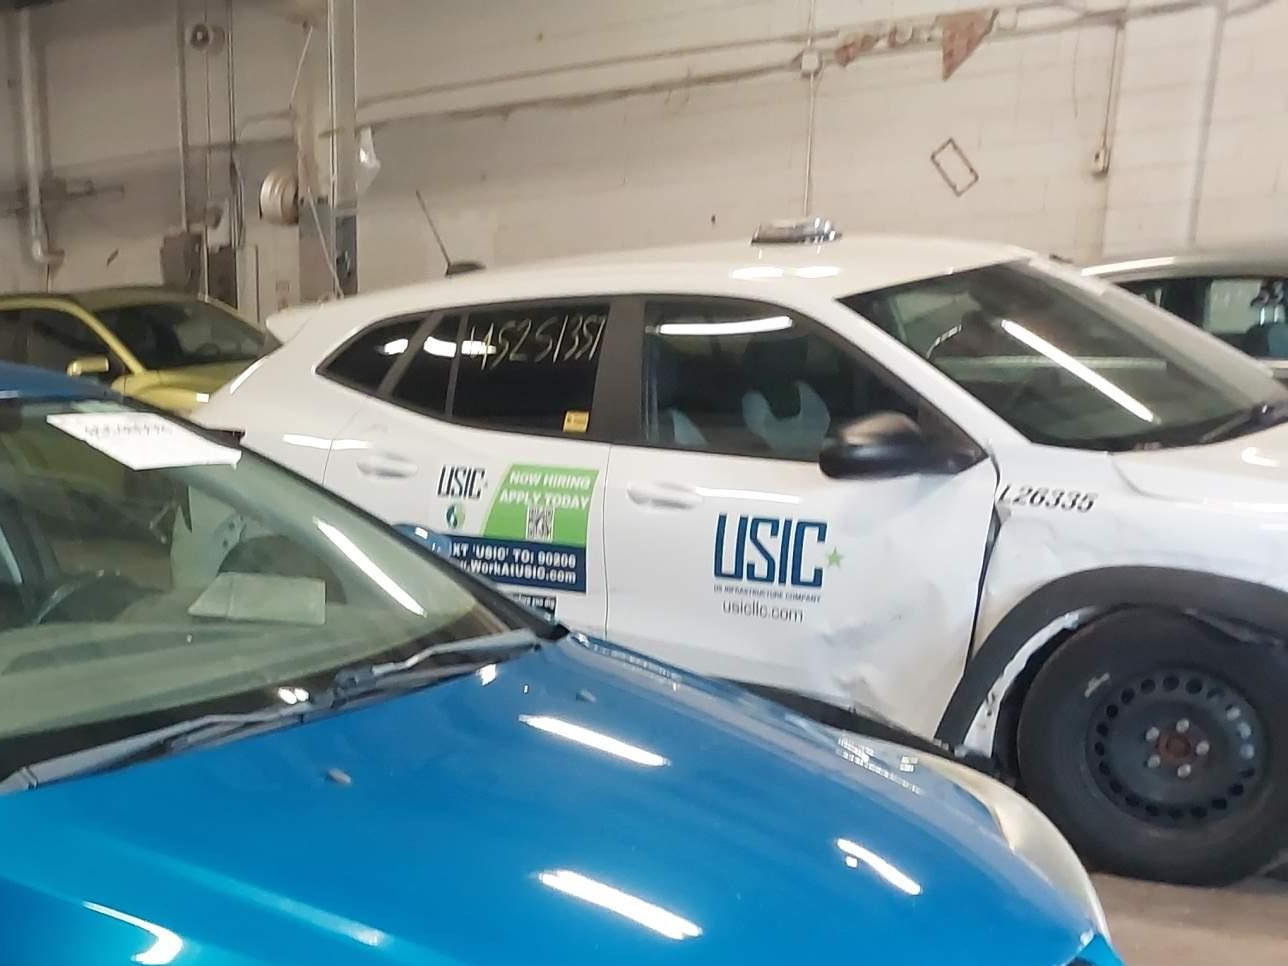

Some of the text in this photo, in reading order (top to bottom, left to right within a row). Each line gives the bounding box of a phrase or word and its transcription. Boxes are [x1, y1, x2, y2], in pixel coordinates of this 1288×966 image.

[437, 464, 486, 499] USIC
[509, 471, 591, 489] NOW HIRING
[500, 491, 589, 509] APPLY TODAY
[714, 513, 828, 588] USIC
[785, 591, 821, 604] COMPANY
[722, 600, 804, 623] usicllc.com
